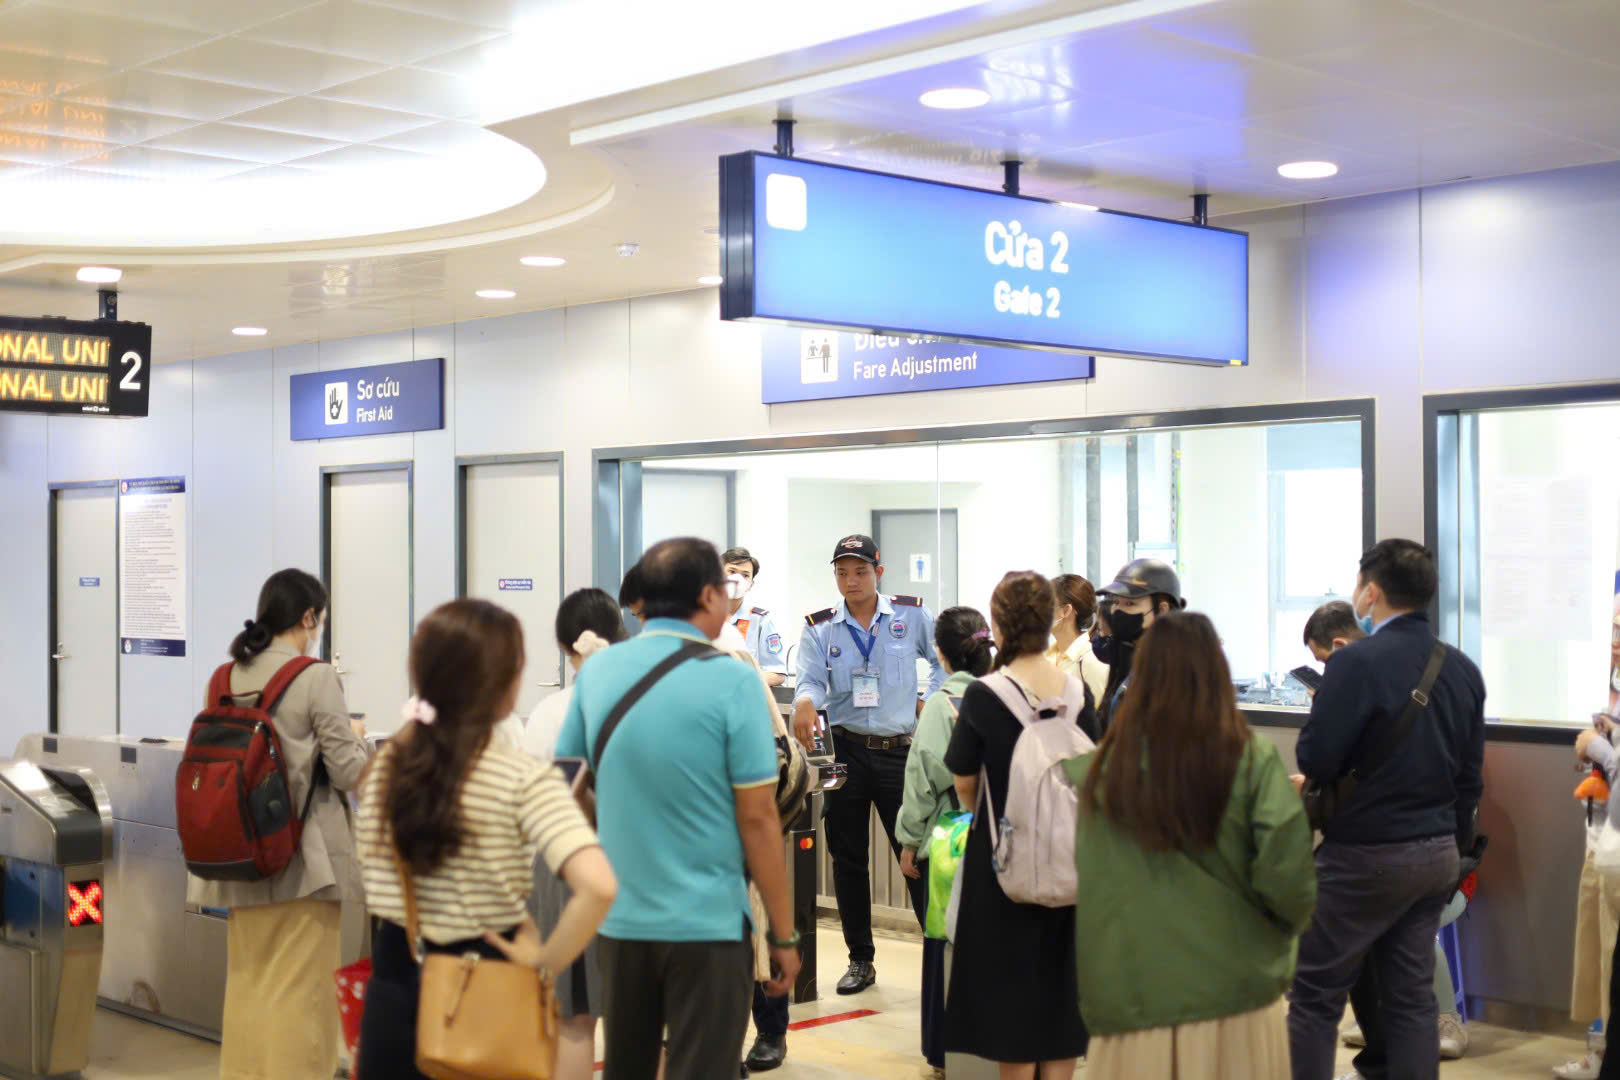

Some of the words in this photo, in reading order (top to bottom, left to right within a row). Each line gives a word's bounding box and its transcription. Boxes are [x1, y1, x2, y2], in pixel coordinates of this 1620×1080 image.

[985, 220, 1044, 270] Cửa
[1050, 231, 1069, 274] 2
[993, 280, 1043, 316] Gate
[1046, 287, 1061, 318] 2
[0, 333, 54, 361] NAL
[62, 337, 110, 364] UNI
[119, 351, 143, 390] 2
[853, 360, 887, 380] Fare
[890, 351, 978, 380] Adjustment
[0, 371, 53, 399] NAL
[60, 375, 109, 401] UNI
[356, 380, 374, 400] Sơ
[376, 376, 400, 398] cứu
[356, 408, 376, 422] First
[377, 406, 393, 421] Aid
